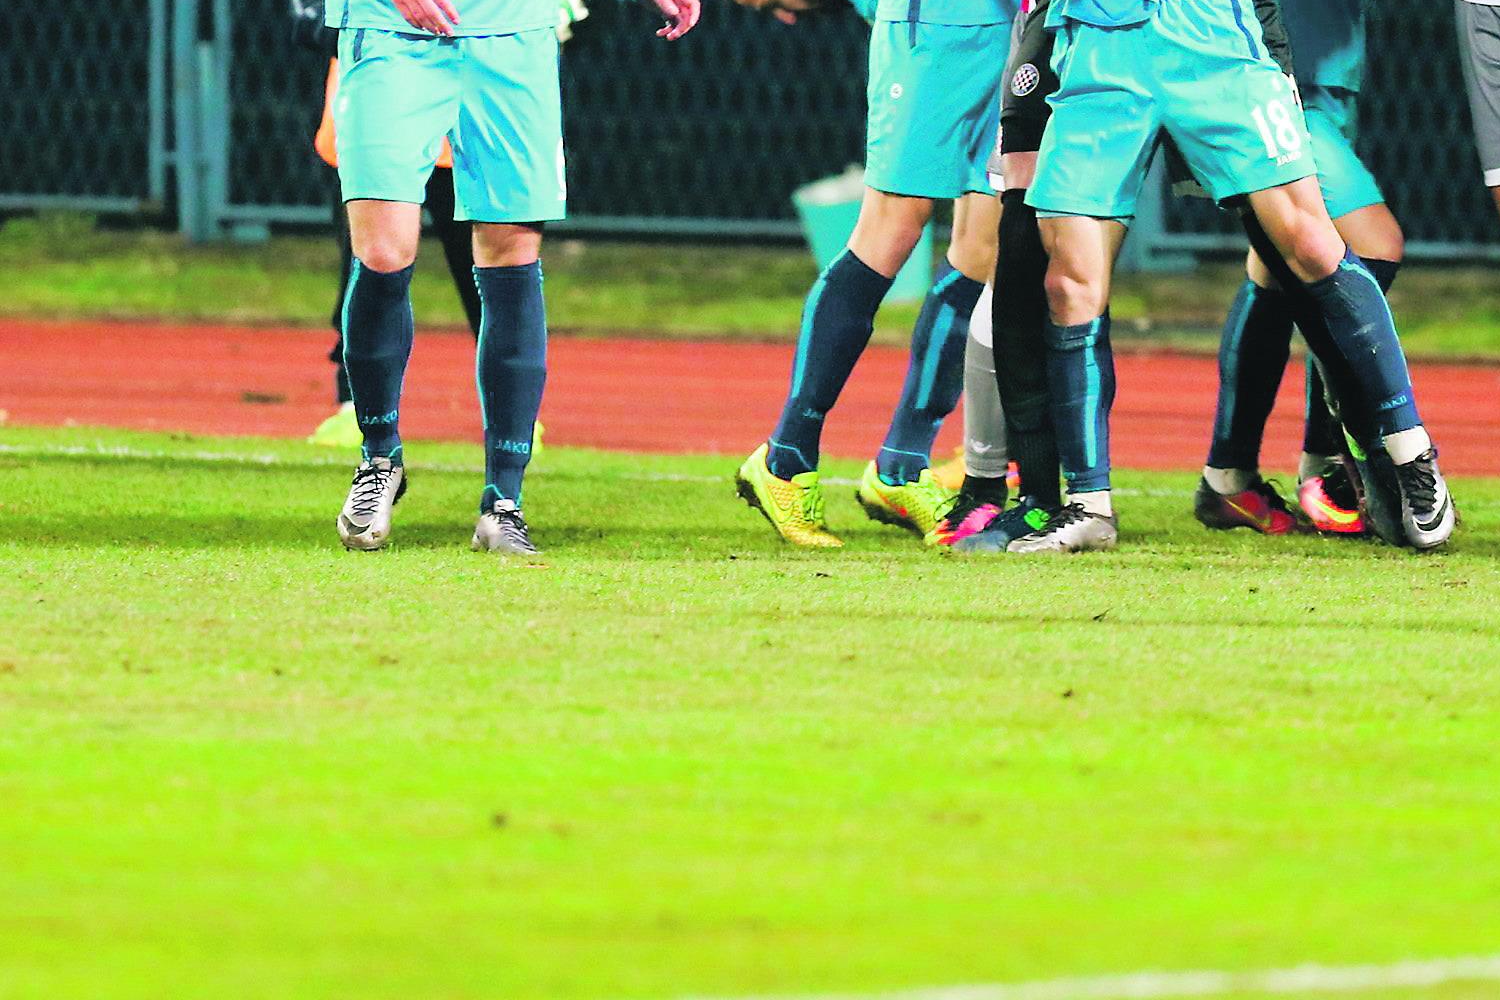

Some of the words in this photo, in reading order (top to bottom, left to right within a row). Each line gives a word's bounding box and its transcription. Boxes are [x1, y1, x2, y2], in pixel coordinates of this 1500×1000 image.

[1250, 100, 1302, 158] 18
[361, 409, 397, 425] JAKO
[495, 440, 530, 455] JAKO
